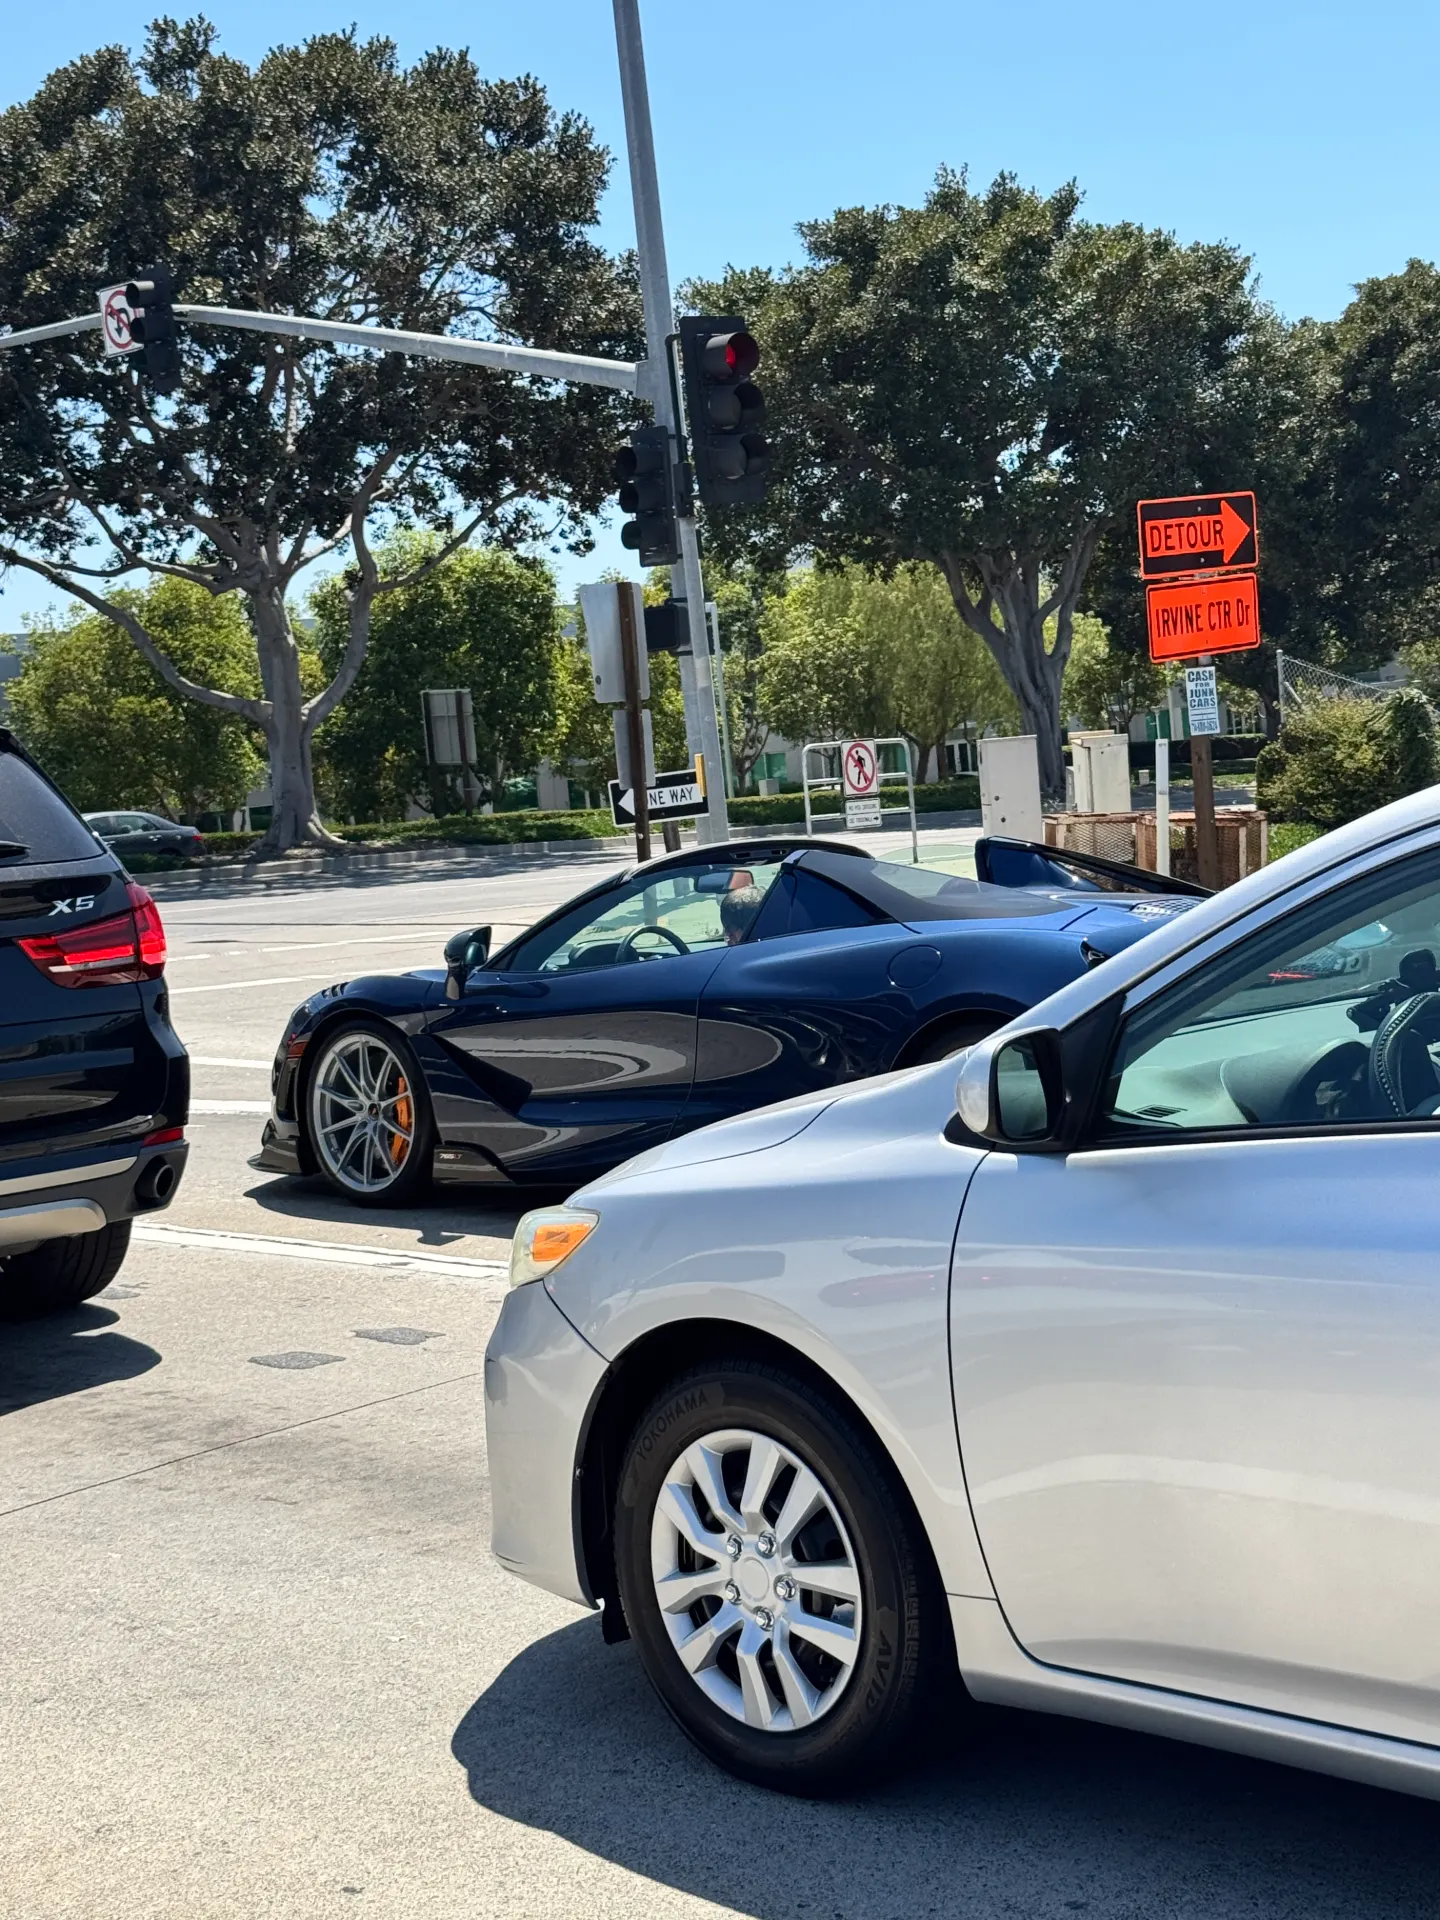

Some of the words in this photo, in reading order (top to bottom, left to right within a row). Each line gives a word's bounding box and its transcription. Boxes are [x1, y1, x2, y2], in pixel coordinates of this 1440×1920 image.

[1150, 519, 1224, 552] DETOUR
[1156, 603, 1203, 638] IRVINE
[1208, 600, 1232, 631] CTR
[1236, 598, 1250, 627] Dr
[1187, 670, 1214, 682] CASH
[1190, 688, 1215, 698] JUNK
[1190, 698, 1216, 708] CARS
[648, 790, 666, 806] NE
[669, 786, 693, 804] WAY
[47, 894, 95, 916] X5
[636, 1388, 709, 1460] YOKOHAMA
